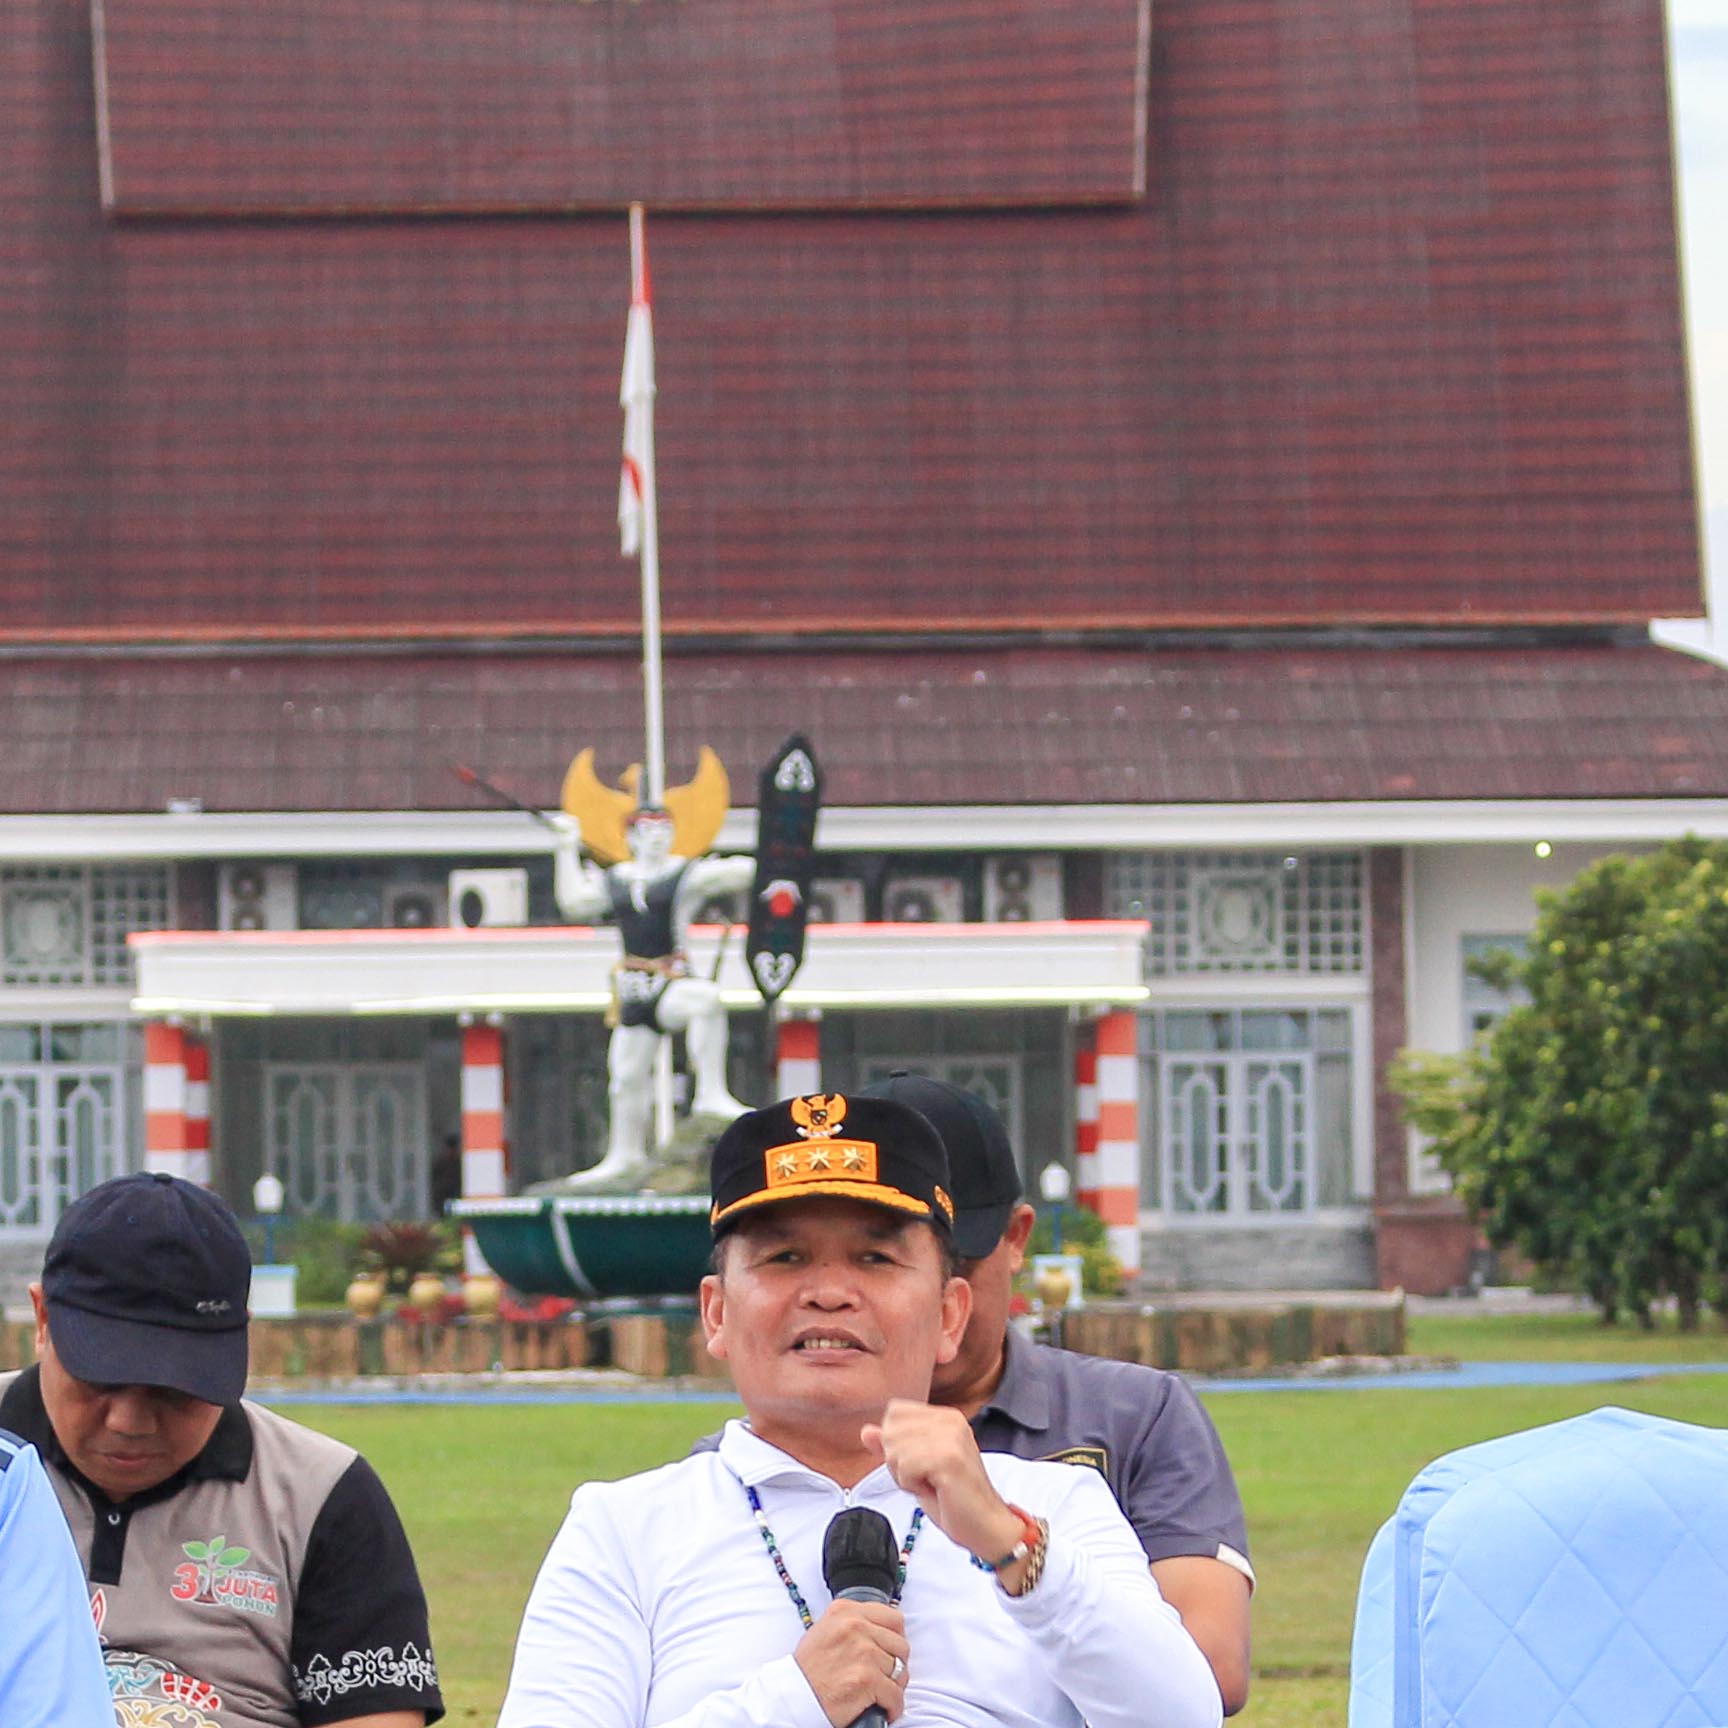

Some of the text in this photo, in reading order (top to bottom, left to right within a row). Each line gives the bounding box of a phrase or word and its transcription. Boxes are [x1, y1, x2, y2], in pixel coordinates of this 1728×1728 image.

[171, 1562, 199, 1600] 3
[216, 1577, 278, 1604] JUTA
[221, 1596, 276, 1617] POHON
